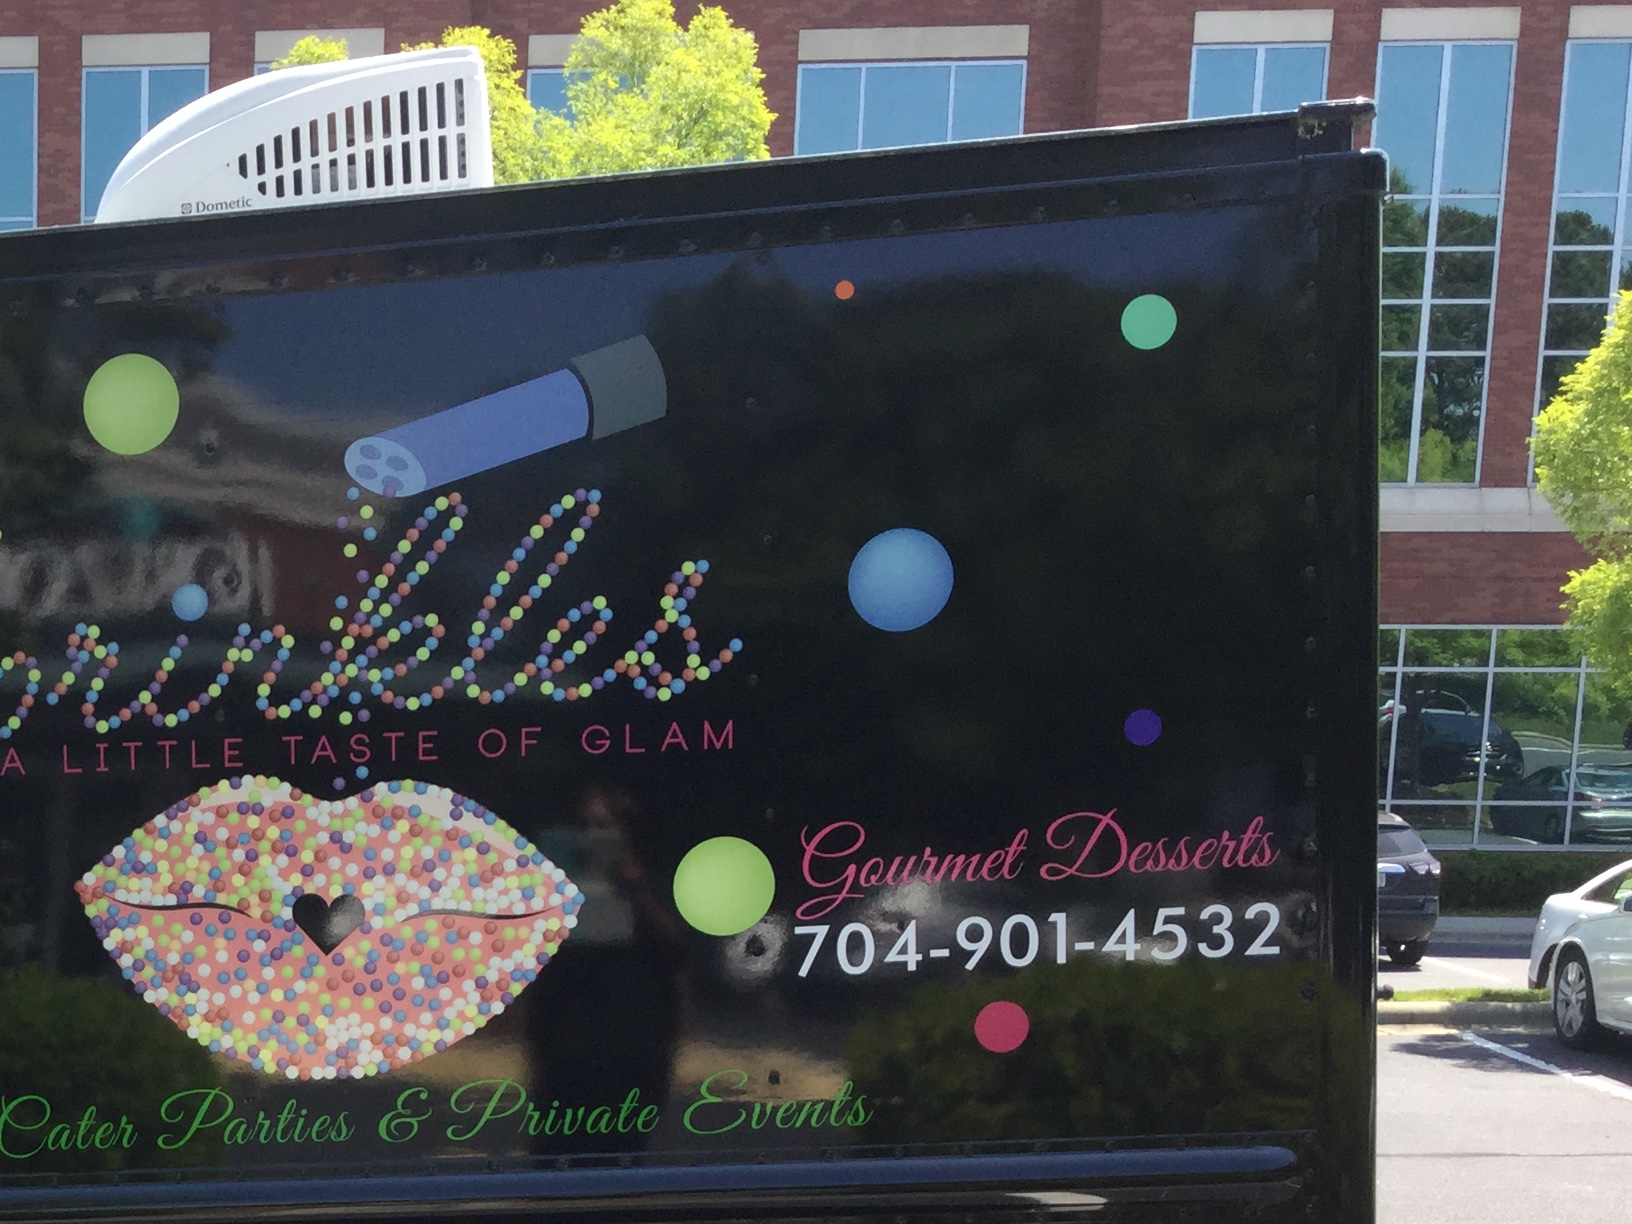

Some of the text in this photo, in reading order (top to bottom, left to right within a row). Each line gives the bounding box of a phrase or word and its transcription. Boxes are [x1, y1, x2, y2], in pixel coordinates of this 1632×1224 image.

[195, 196, 253, 214] Dometic
[0, 720, 734, 776] A LITTLE TASTE OF GLAM
[795, 808, 1281, 920] Gourmet Desserts
[794, 901, 1281, 978] 704-901-4532
[156, 1086, 356, 1150] Parties
[377, 1087, 433, 1143] &
[446, 1077, 660, 1141] Private
[683, 1069, 875, 1135] Events
